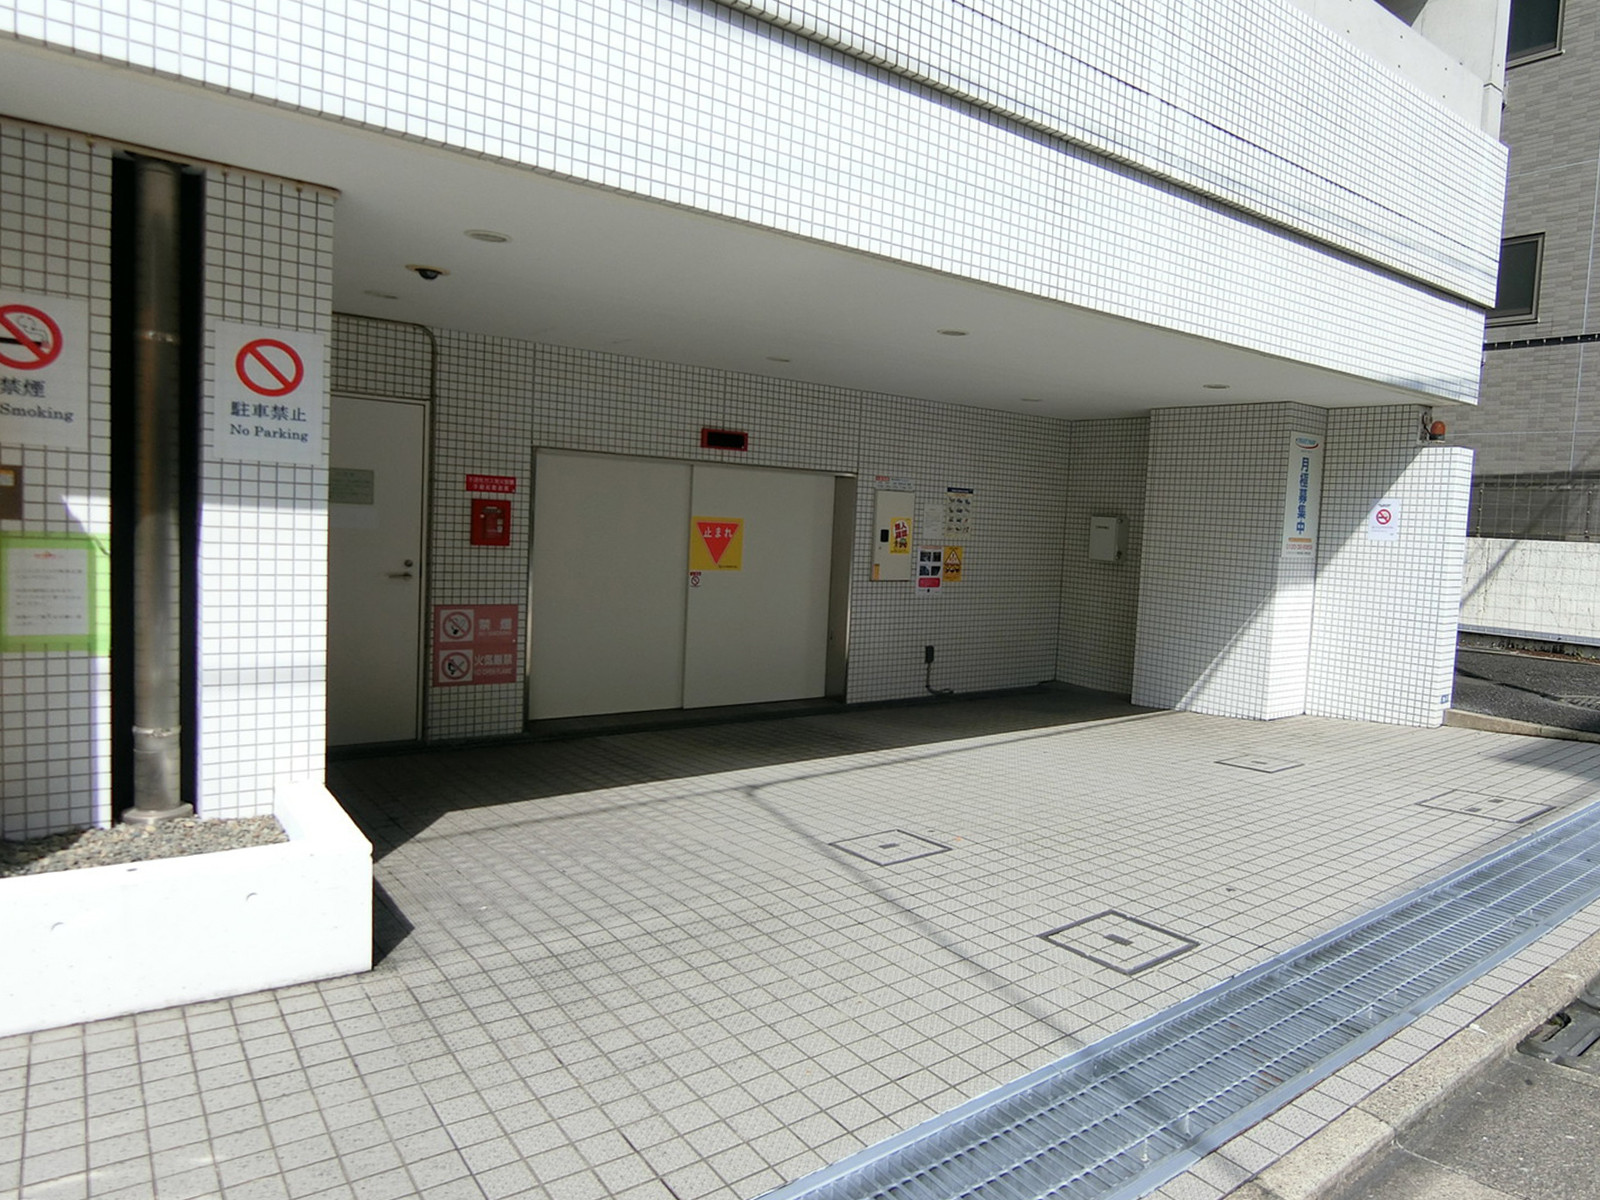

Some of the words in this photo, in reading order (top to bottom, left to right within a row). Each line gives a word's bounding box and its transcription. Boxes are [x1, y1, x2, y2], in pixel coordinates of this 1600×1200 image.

[0, 376, 46, 398] 禁煙
[0, 403, 75, 423] Smoking
[231, 401, 307, 422] 駐車禁止
[230, 423, 250, 436] No
[254, 426, 308, 443] Parking
[1296, 457, 1310, 535] 月極募集中
[703, 526, 733, 539] 止まれ
